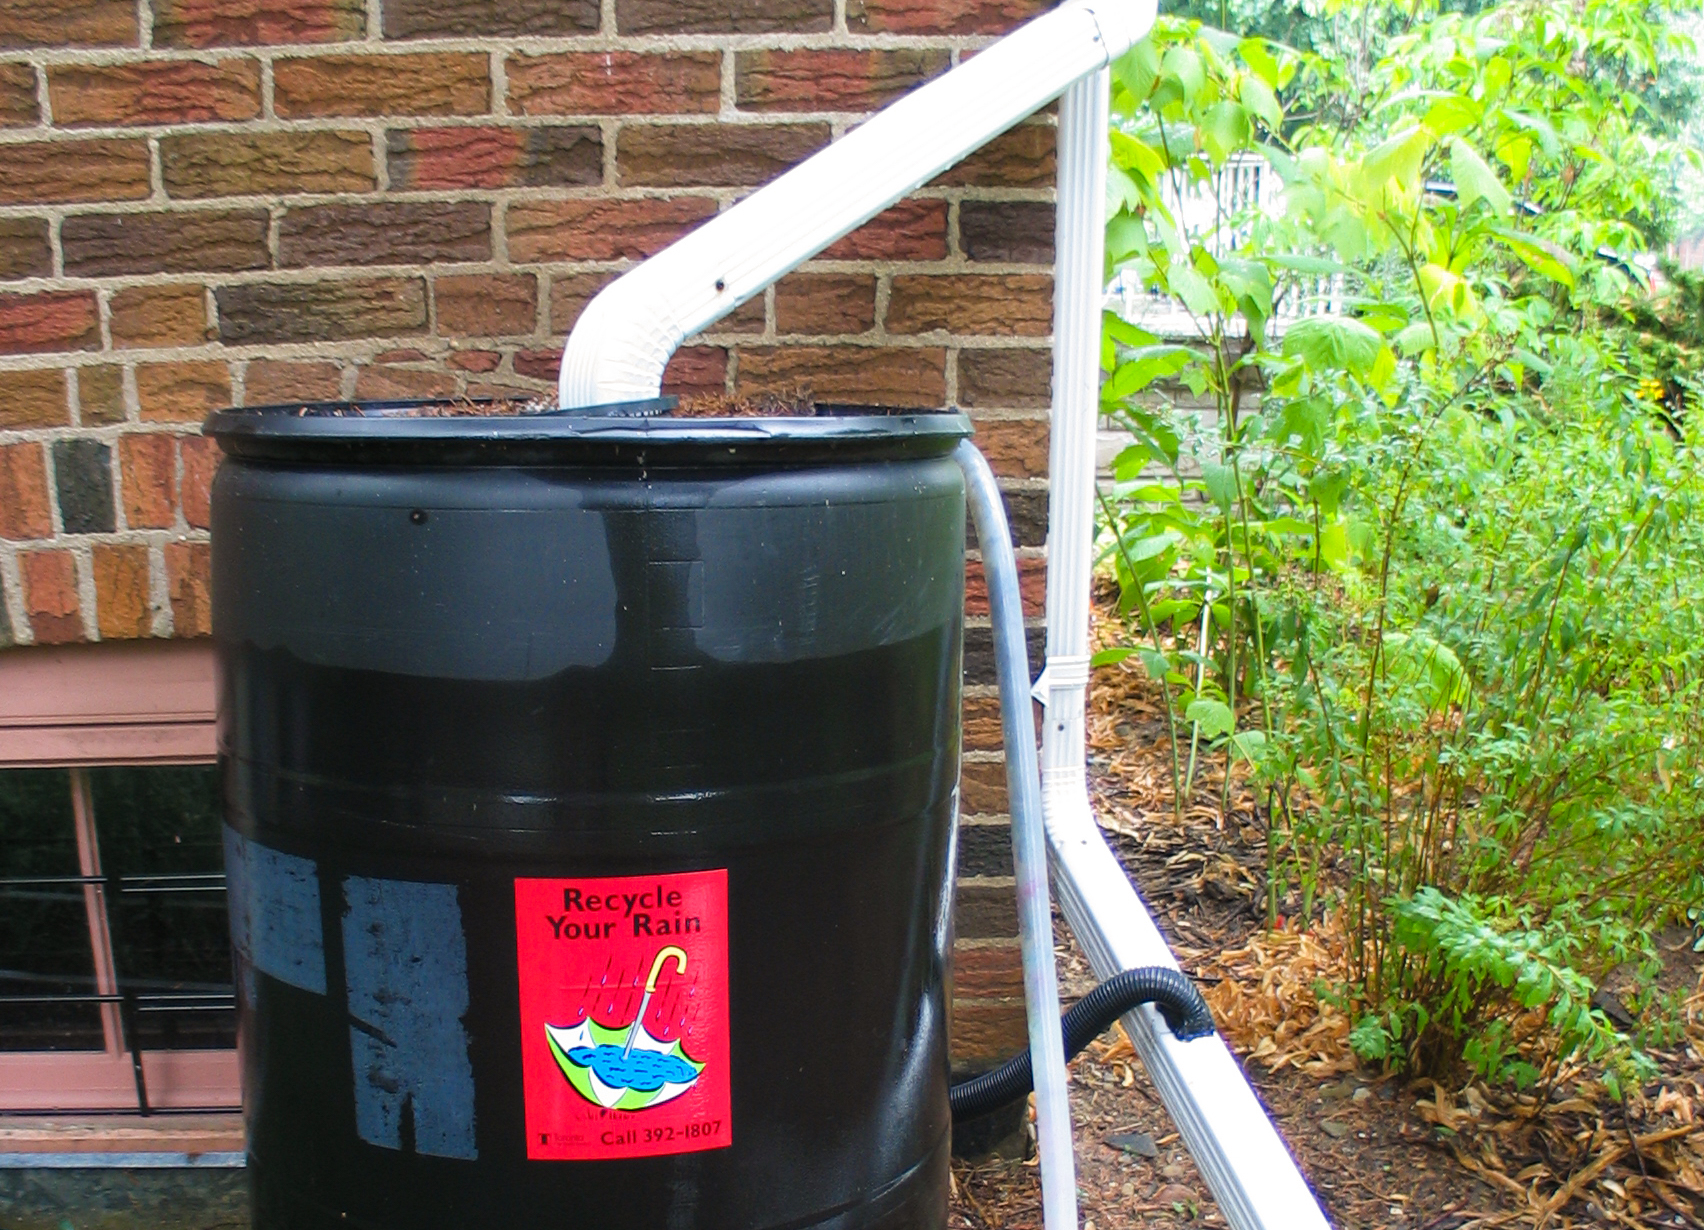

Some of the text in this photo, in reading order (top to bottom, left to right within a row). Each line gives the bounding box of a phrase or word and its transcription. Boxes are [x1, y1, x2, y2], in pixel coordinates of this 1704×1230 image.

[563, 884, 682, 918] Recycle
[546, 910, 701, 940] Your Rain
[601, 1120, 722, 1146] Call 392-1807
